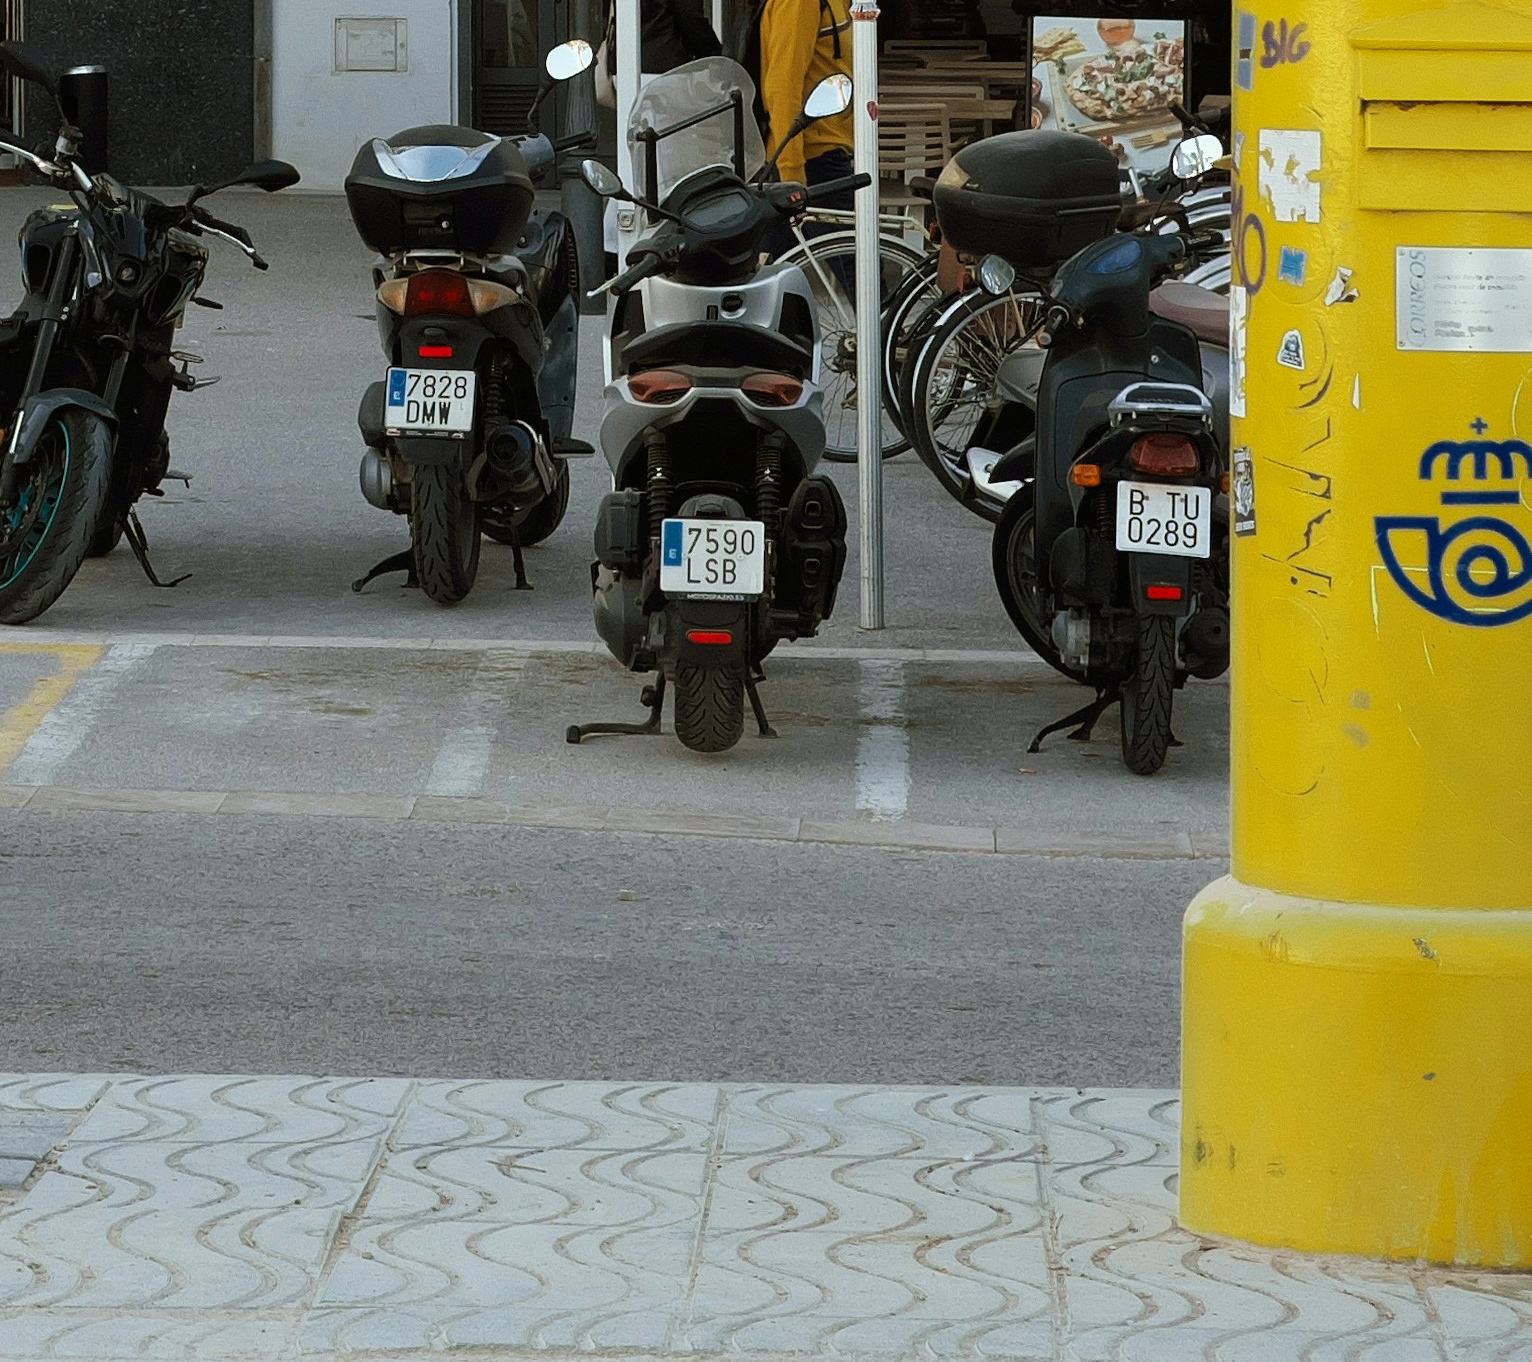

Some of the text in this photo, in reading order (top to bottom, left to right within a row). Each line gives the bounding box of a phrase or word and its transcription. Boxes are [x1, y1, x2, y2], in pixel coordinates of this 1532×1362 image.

[1261, 18, 1311, 68] BIG
[1407, 250, 1427, 348] CORREOS
[407, 373, 468, 399] 7828
[406, 399, 451, 425] DMW
[1129, 489, 1200, 521] B TU
[688, 527, 755, 555] 7590
[1128, 517, 1198, 549] 0289
[687, 557, 737, 584] LSB
